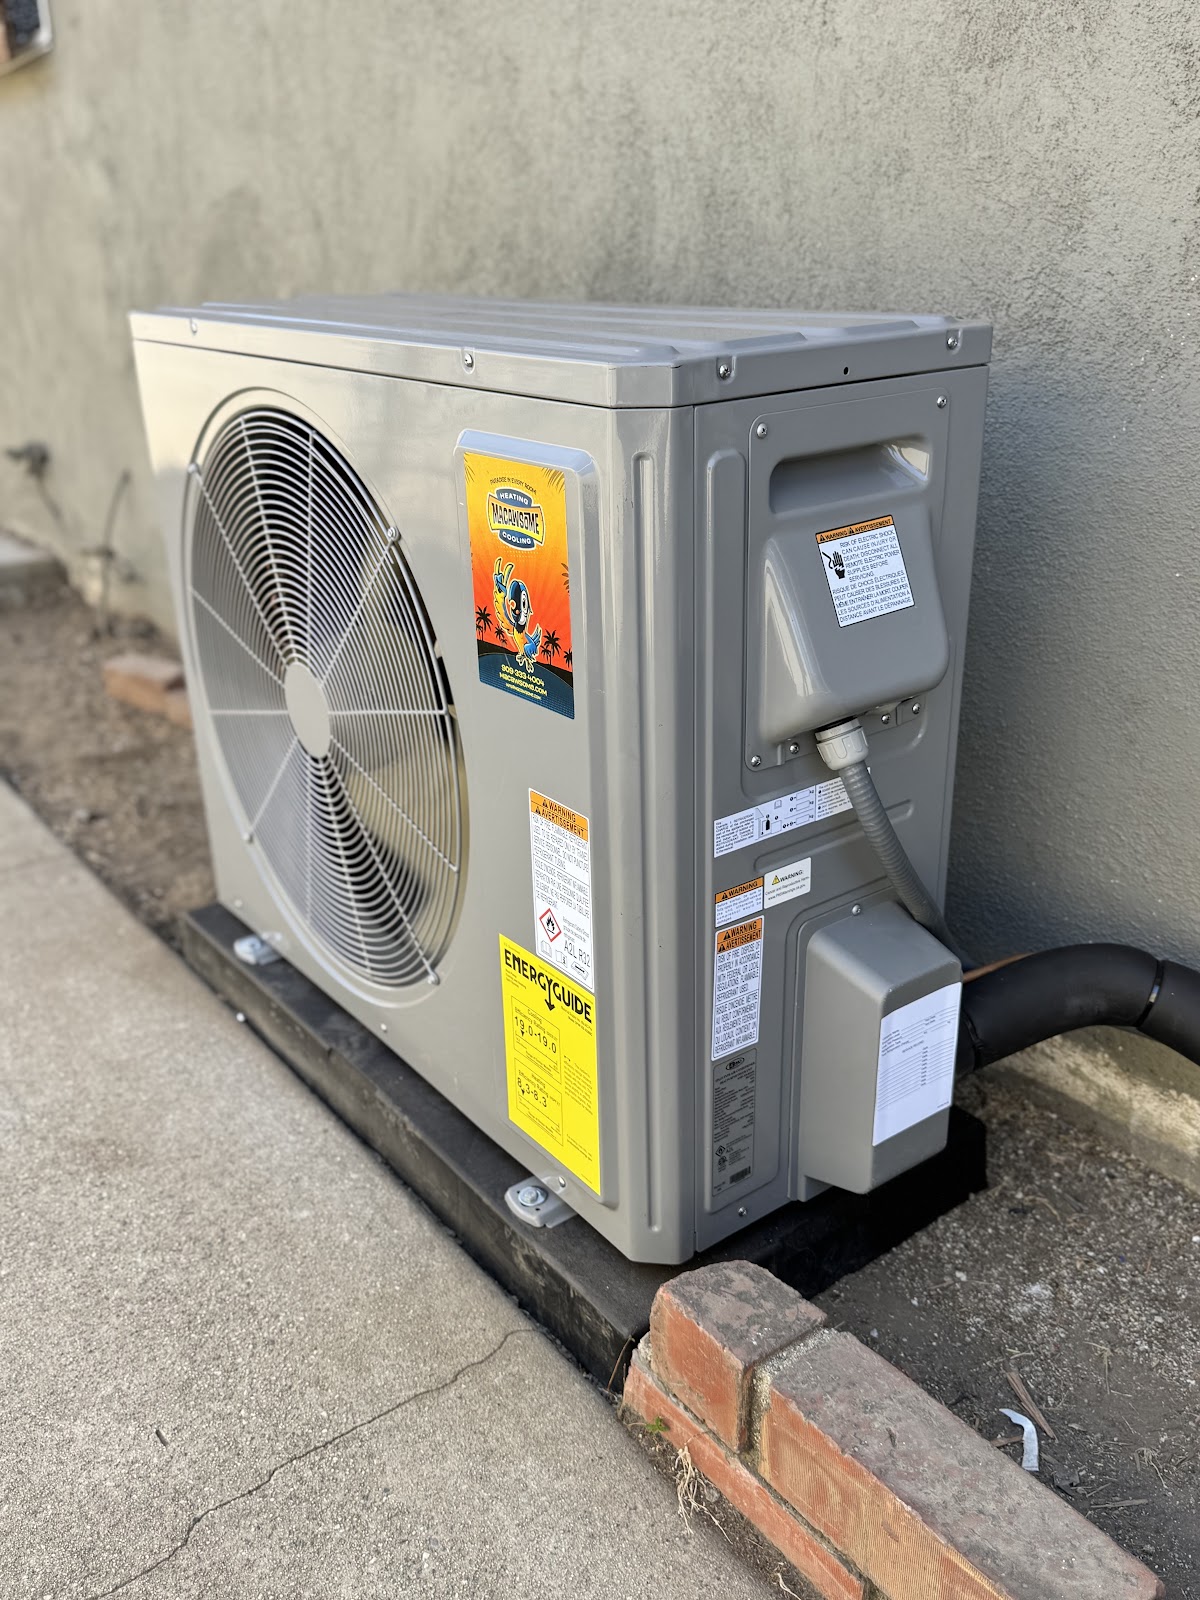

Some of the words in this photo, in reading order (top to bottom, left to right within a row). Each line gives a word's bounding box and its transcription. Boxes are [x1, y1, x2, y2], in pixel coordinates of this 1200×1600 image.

[500, 492, 528, 505] HEATING
[492, 502, 539, 534] MACAWSOME
[502, 532, 531, 544] COOLING
[542, 807, 584, 838] AVERTISSEMENT
[549, 801, 576, 823] WARNING
[729, 881, 757, 896] WARNING
[726, 929, 761, 950] AVERTISSEMENT
[732, 921, 757, 938] WARNING
[563, 938, 577, 960] A2L
[578, 947, 591, 968] R32
[504, 947, 592, 1024] ENERGYGUIDE
[514, 1014, 557, 1055] 19.0-19.0
[517, 1076, 547, 1109] 8.3-8.3
